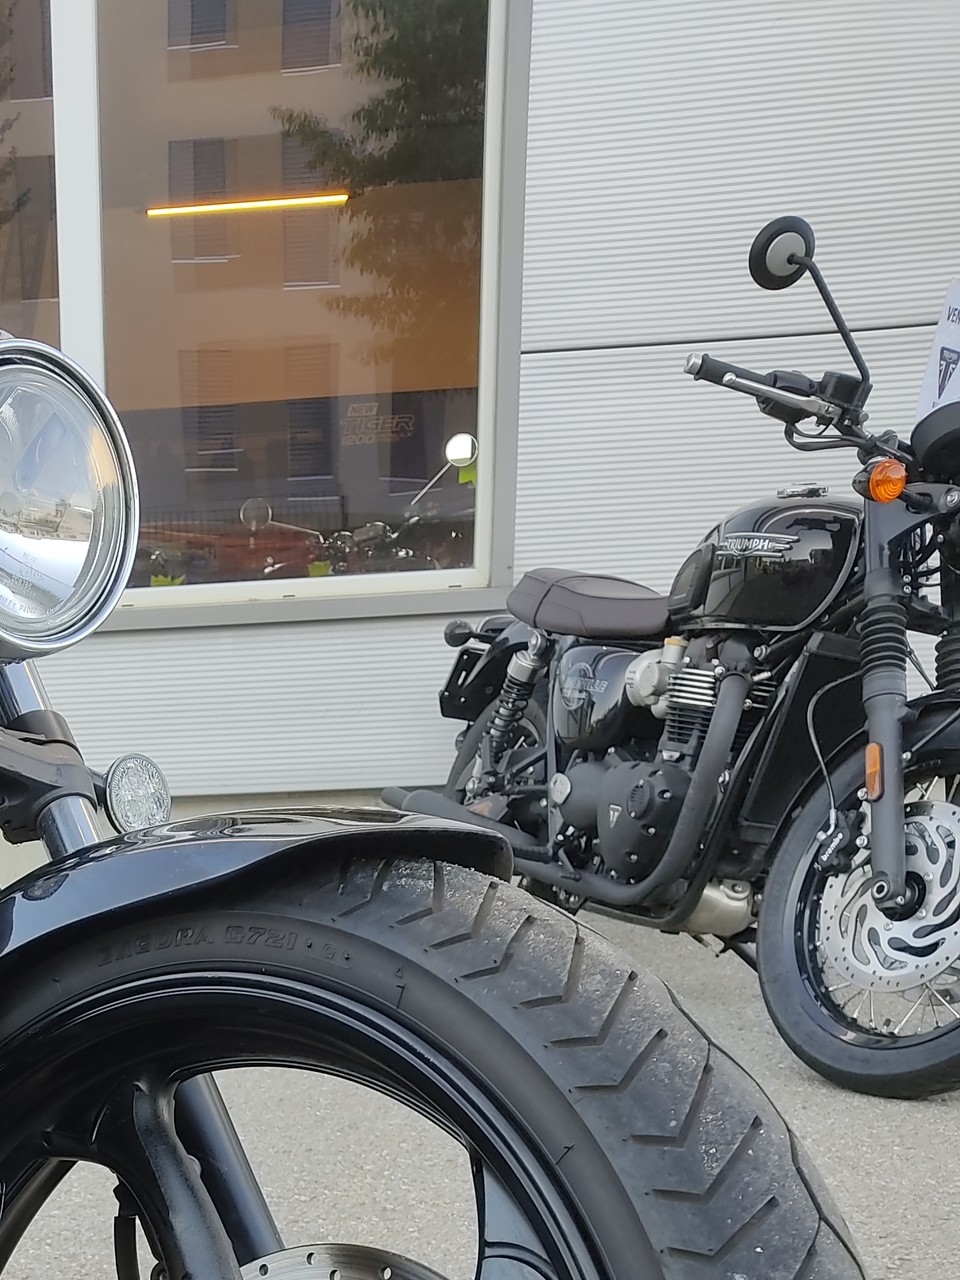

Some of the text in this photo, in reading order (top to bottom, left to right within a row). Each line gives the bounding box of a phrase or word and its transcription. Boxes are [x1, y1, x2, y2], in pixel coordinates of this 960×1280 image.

[350, 404, 377, 416] NEW
[341, 414, 415, 435] TIGER
[725, 537, 771, 551] TRIUMPH
[820, 832, 844, 862] brembo
[97, 926, 216, 968] EEDRA
[224, 925, 299, 952] G721
